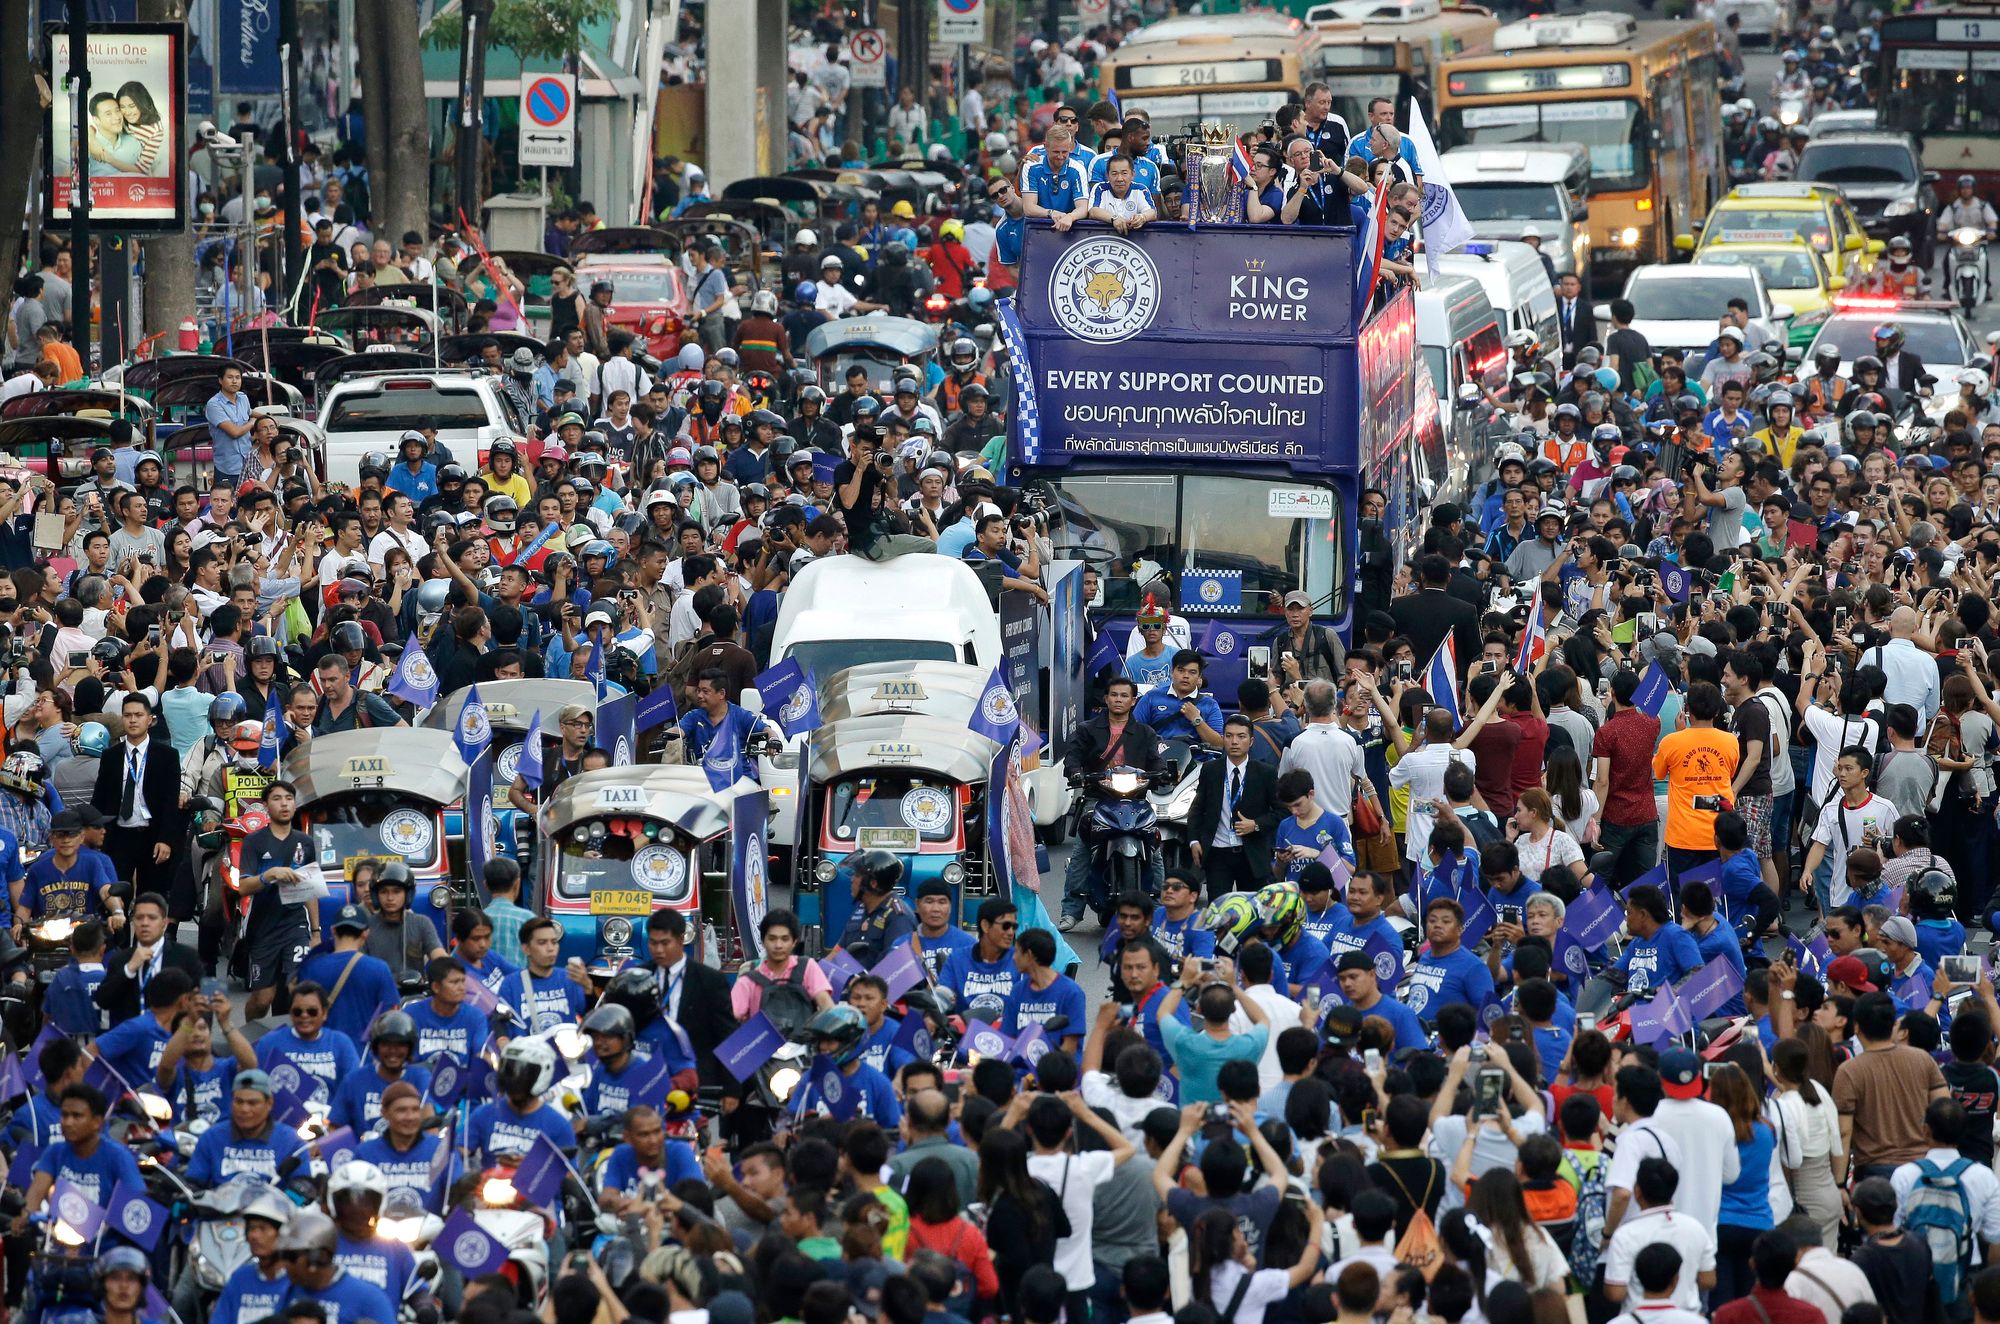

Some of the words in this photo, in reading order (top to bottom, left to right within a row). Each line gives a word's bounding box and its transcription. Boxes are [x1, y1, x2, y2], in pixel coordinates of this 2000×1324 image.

[1963, 24, 1980, 38] 13
[87, 44, 102, 55] All
[107, 44, 118, 55] in
[123, 44, 147, 55] One
[1179, 67, 1218, 84] 204
[1059, 244, 1129, 287] LEICESTER
[1129, 257, 1151, 288] CITY
[1230, 275, 1309, 300] KING
[1058, 295, 1123, 336] FOOTBALL
[1123, 296, 1150, 330] CLUB
[1229, 302, 1307, 321] POWER
[1047, 370, 1113, 390] EVERY
[1119, 372, 1213, 393] SUPPORT
[1218, 374, 1324, 395] COUNTED
[1064, 400, 1306, 428] ขอบคุณทุกพลังใจคนไทย
[1284, 441, 1304, 456] ลีก
[537, 530, 550, 546] CITY
[883, 682, 917, 695] TAXI
[484, 704, 505, 713] AXI
[880, 744, 911, 752] TAXI
[1698, 746, 1720, 758] FINDERS
[349, 759, 384, 772] TAXI
[604, 789, 638, 802] TAXI
[906, 790, 937, 807] LEICESTER
[936, 796, 947, 810] CITY
[385, 811, 418, 830] LEICESTER
[417, 816, 429, 833] CITY
[906, 809, 933, 828] FOOTBALL
[933, 812, 947, 827] CLUB
[385, 832, 413, 851] FOOTBALL
[413, 834, 428, 850] CLUB
[636, 847, 670, 865] LEICESTER
[669, 853, 681, 870] CITY
[636, 867, 665, 888] FOOTBALL
[665, 870, 681, 886] CLUB
[40, 881, 90, 894] CHAMPIONS
[617, 892, 648, 904] 7045
[1302, 922, 1333, 931] EARLESS
[1581, 905, 1614, 937] #LCFCChampions
[1334, 932, 1367, 947] FEARLESS
[967, 972, 1012, 983] FEARLESS
[520, 988, 566, 1001] FARLESS
[963, 981, 1012, 997] CHAMPIONS
[1691, 974, 1728, 1005] #LCFCChampions
[1020, 1003, 1056, 1013] FEARLESS
[420, 1028, 467, 1039] FEARLESS
[224, 1146, 275, 1160] FEARLESS
